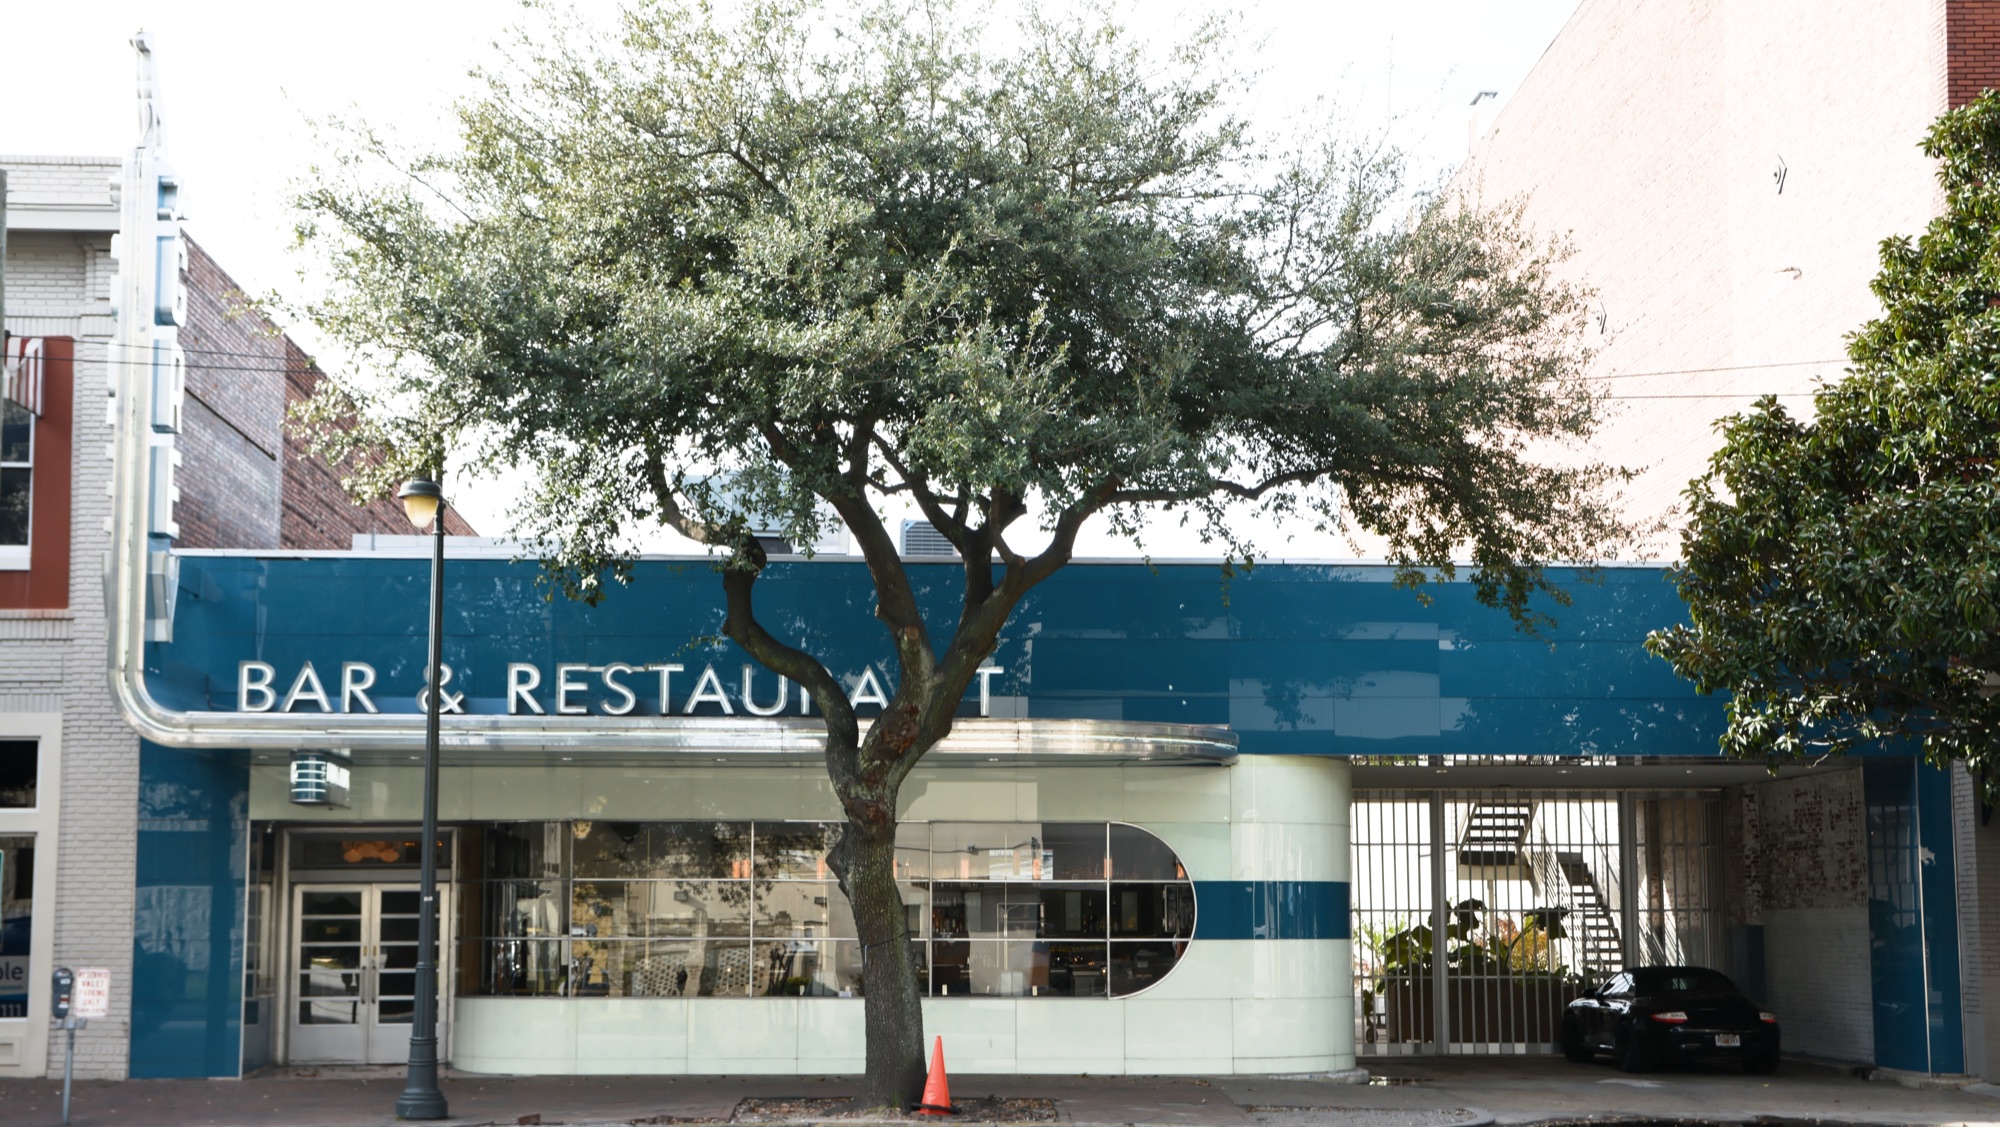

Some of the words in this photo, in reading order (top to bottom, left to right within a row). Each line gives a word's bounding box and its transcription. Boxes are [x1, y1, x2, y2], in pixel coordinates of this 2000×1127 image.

[237, 660, 378, 713] BAR
[416, 662, 466, 714] &
[507, 662, 1005, 716] RESTAUAT
